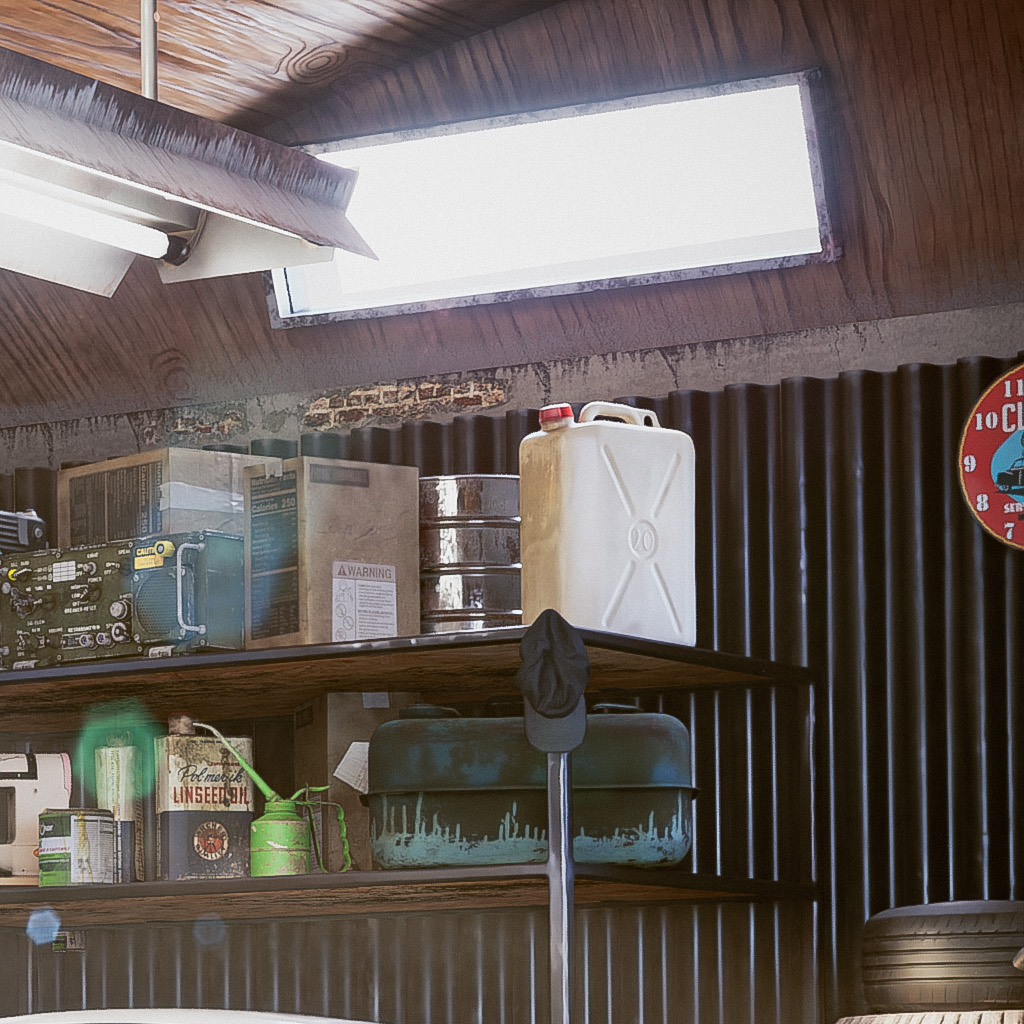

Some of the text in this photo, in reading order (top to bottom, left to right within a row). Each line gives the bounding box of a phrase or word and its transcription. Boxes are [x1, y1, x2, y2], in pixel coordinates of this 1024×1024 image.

[975, 411, 999, 431] 10
[963, 455, 977, 473] 9
[252, 497, 296, 513] Calories 250
[976, 494, 989, 512] 8
[1004, 523, 1015, 540] 7
[136, 547, 155, 556] CAUTI
[347, 565, 392, 579] WARNING
[173, 786, 227, 804] LINSEED
